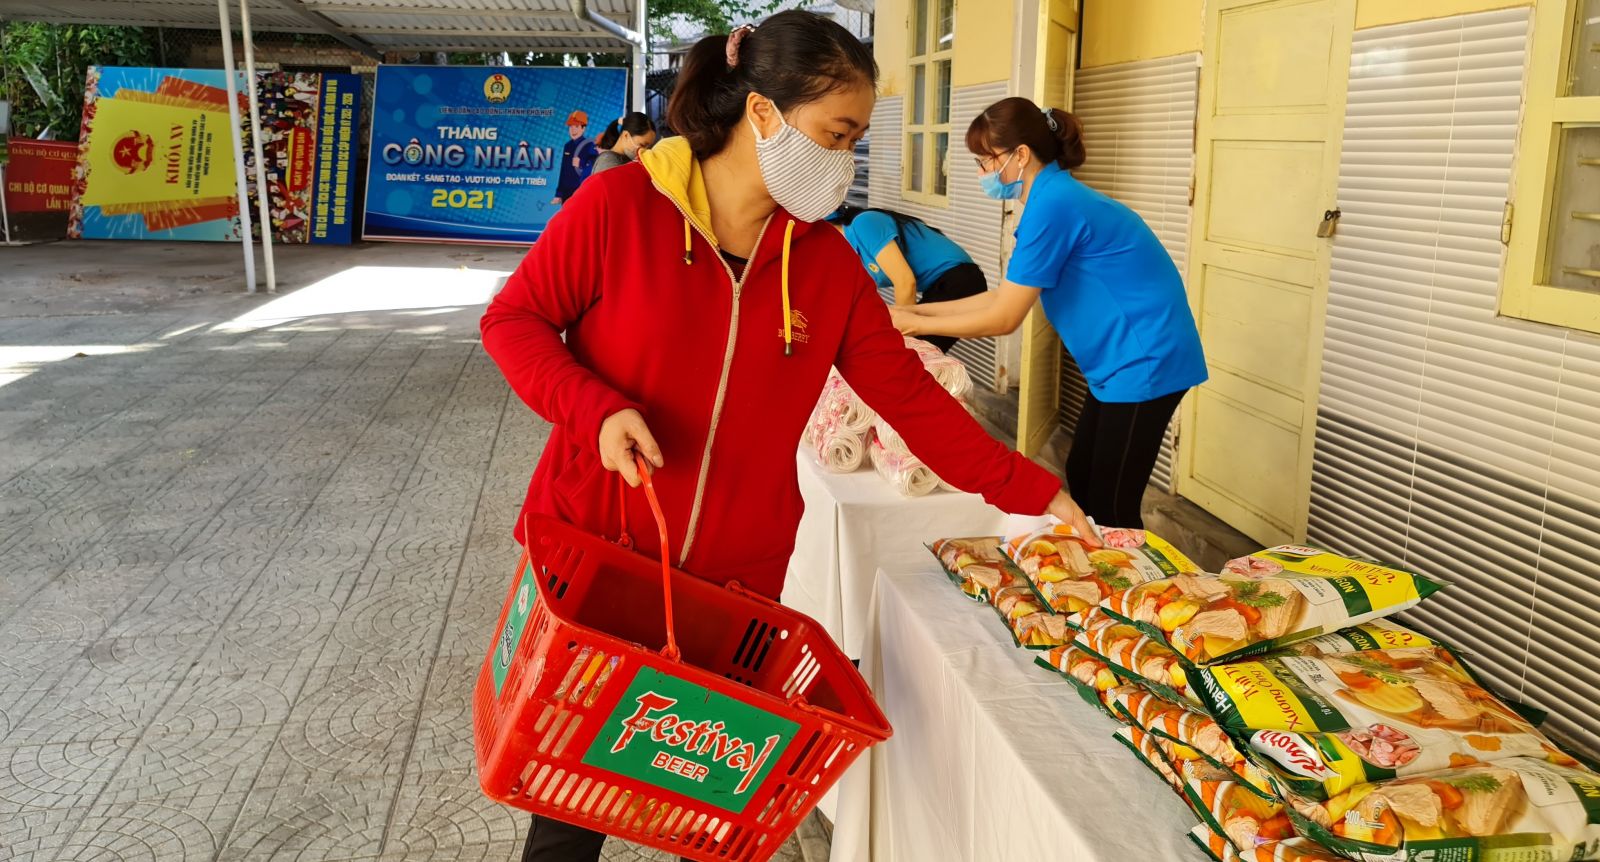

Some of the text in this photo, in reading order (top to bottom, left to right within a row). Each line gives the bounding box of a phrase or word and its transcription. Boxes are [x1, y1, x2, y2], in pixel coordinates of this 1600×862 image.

[437, 124, 498, 140] THÁNG
[163, 122, 184, 184] KHÓA XV
[382, 138, 554, 170] CÔNG NHÂN
[8, 182, 22, 192] CHI
[24, 181, 35, 195] BỘ
[49, 184, 70, 195] QUAN
[431, 188, 495, 209] 2021
[1209, 685, 1232, 714] Hạt
[1270, 688, 1305, 730] Xương
[610, 690, 781, 795] Festival
[1259, 729, 1326, 778] Knorr
[651, 750, 710, 783] BEER
